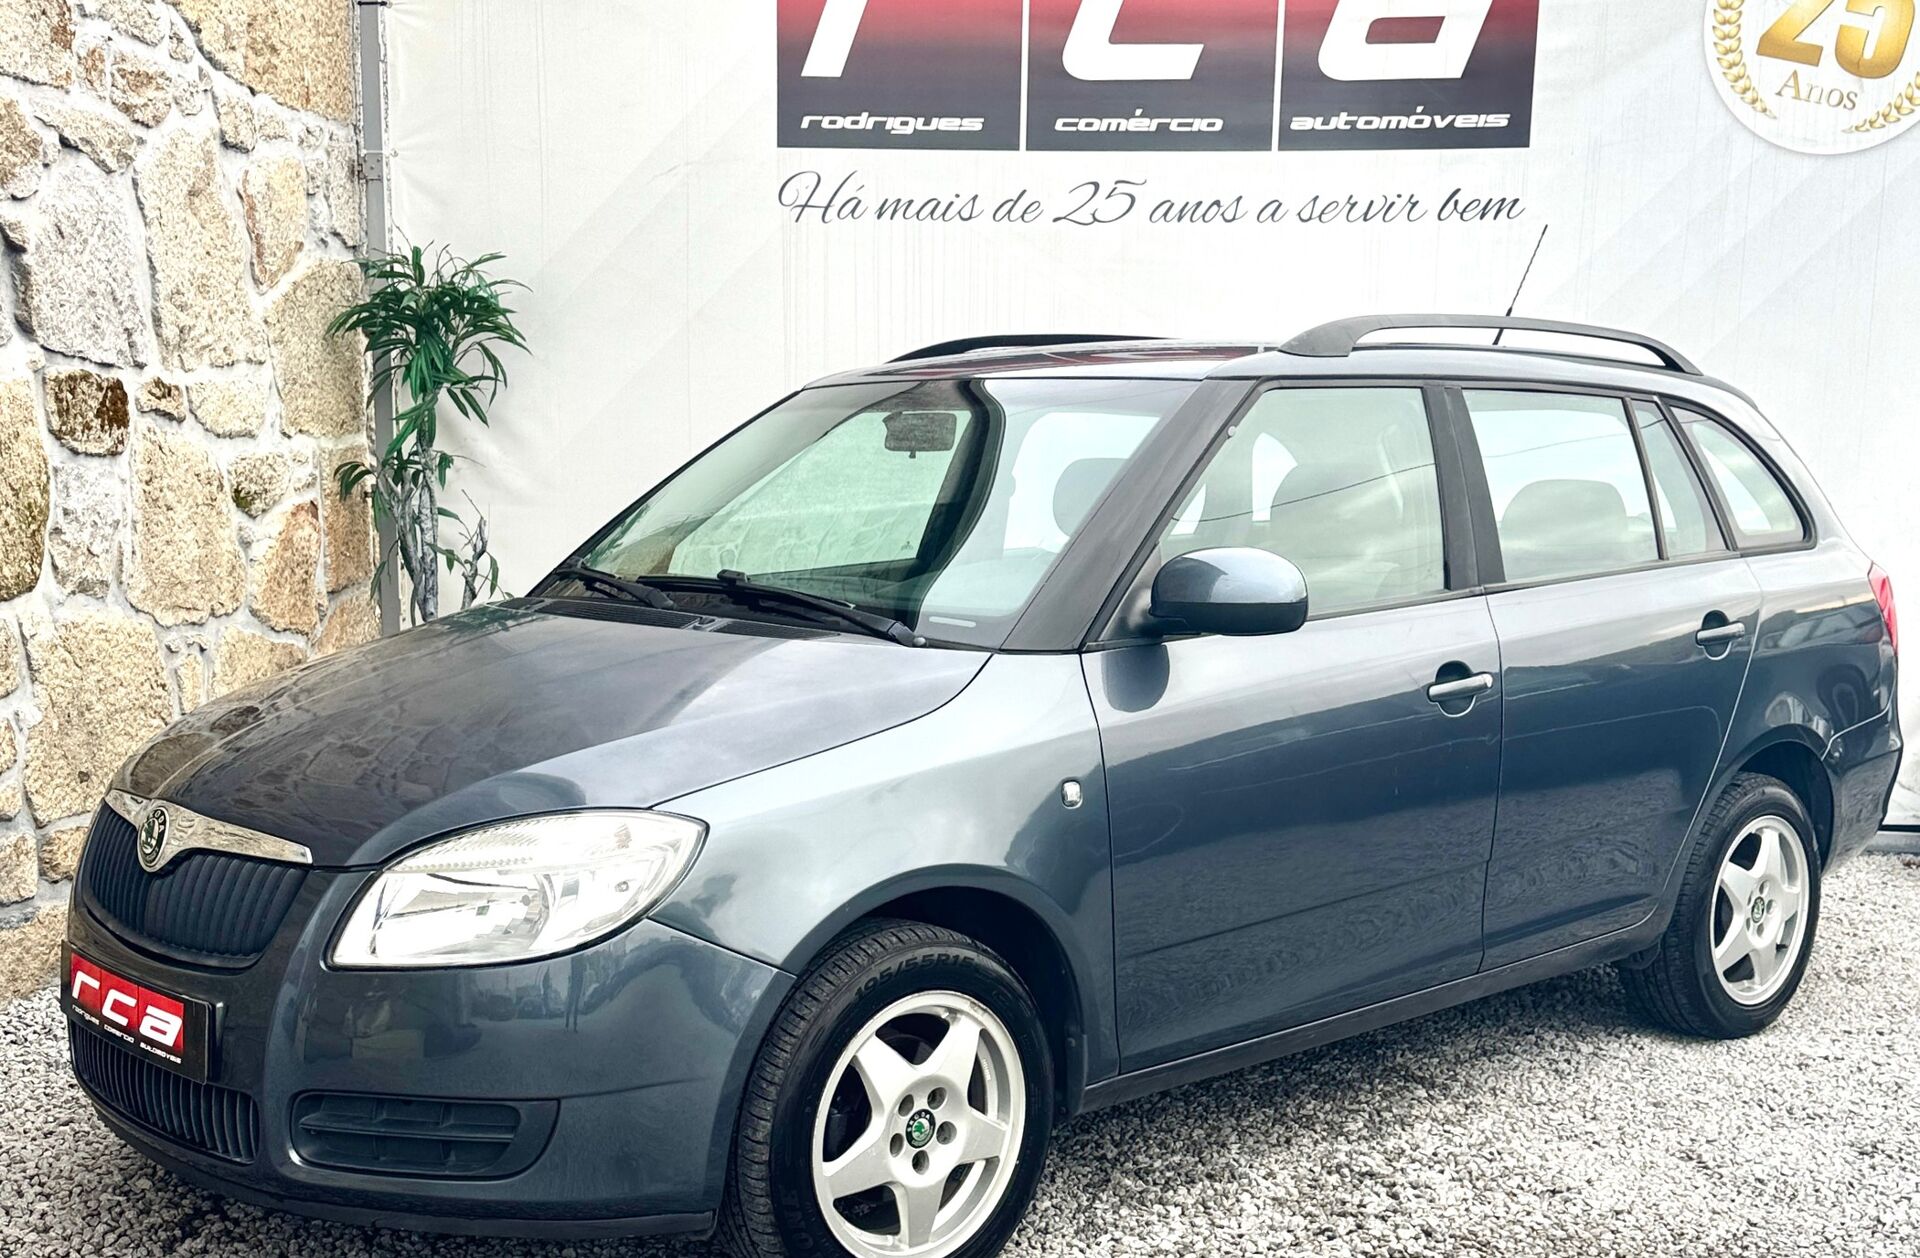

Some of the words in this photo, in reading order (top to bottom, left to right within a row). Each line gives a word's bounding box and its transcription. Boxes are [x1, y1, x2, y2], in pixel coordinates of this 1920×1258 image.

[1775, 69, 1859, 111] Anos
[800, 111, 985, 135] rodrigues
[1054, 108, 1224, 132] comércio
[1290, 105, 1511, 131] automóveis
[778, 170, 868, 224] Há
[874, 193, 984, 222] mais
[992, 189, 1044, 223] de
[1052, 179, 1147, 226] 25
[1150, 195, 1248, 224] anos
[1256, 199, 1288, 224] a
[1296, 194, 1428, 224] servir
[1437, 188, 1526, 223] bem
[71, 970, 183, 1047] rca
